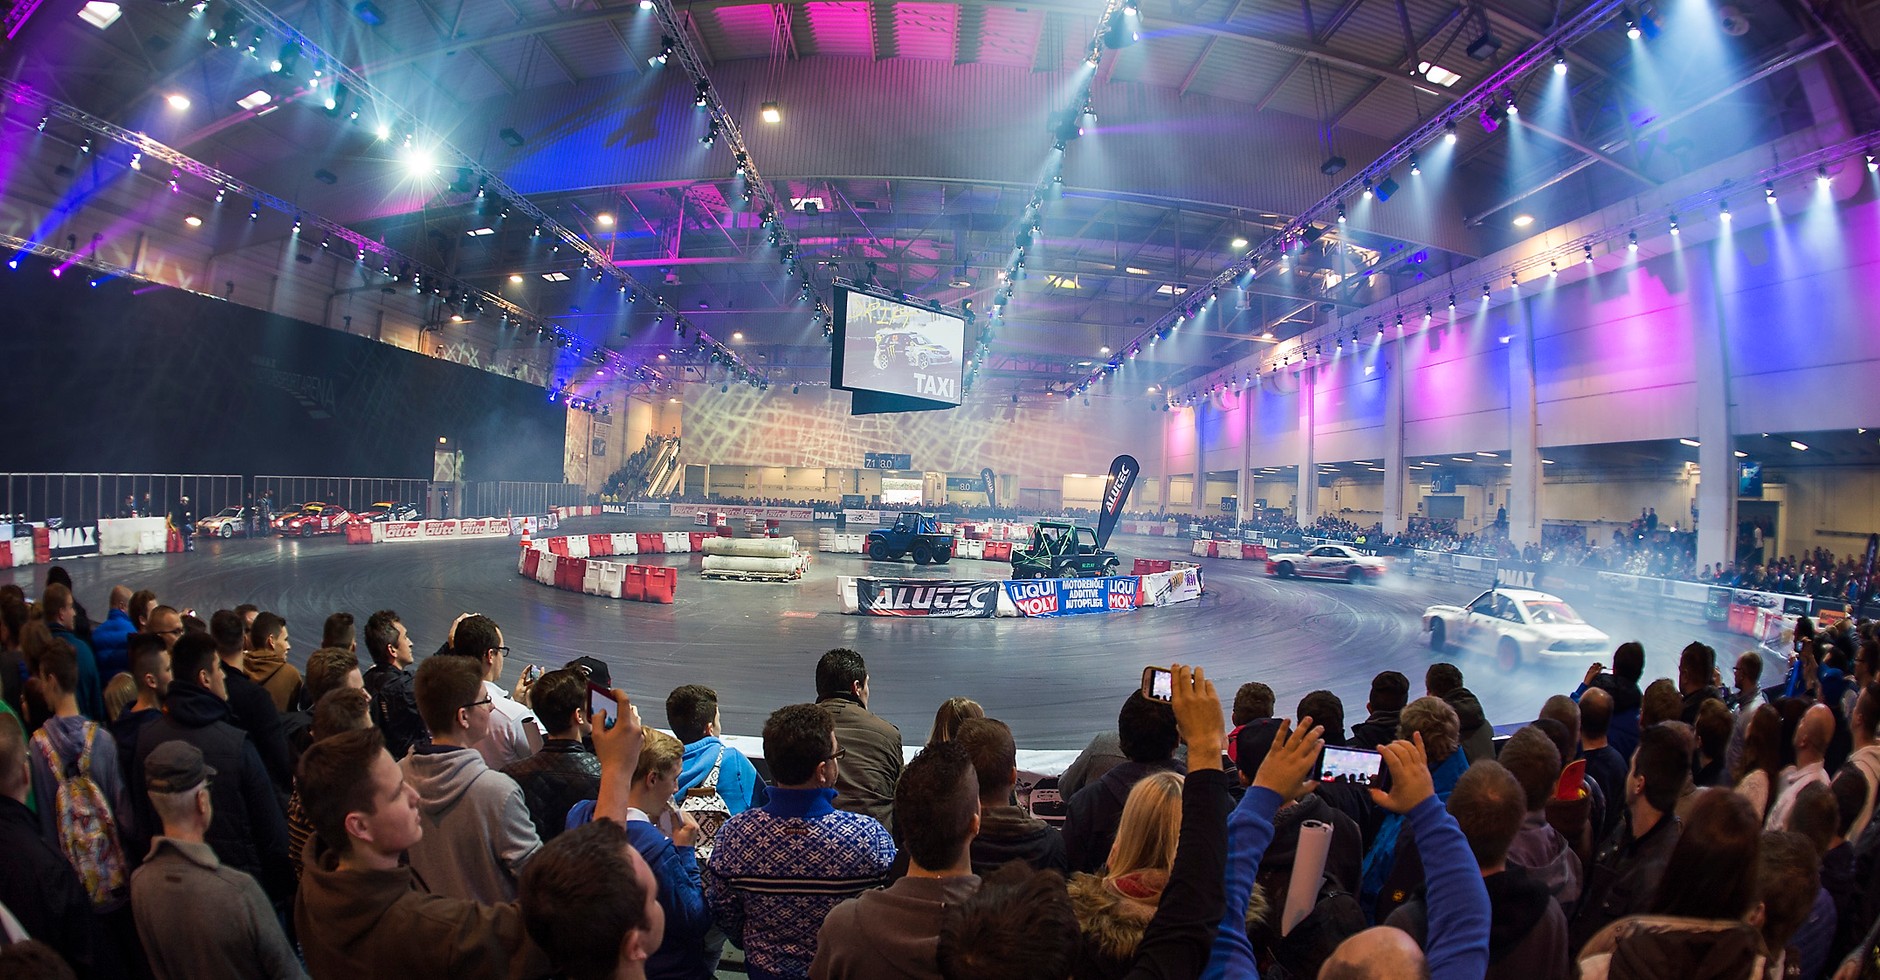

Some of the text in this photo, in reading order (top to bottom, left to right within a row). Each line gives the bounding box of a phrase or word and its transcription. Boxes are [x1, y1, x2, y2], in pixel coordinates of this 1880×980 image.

[913, 373, 955, 398] TAXI
[880, 459, 892, 468] 8.0
[959, 483, 971, 491] 8.0
[1106, 463, 1130, 514] ALUTEC
[603, 505, 626, 514] DMAX
[1221, 502, 1232, 510] 8.0
[387, 528, 418, 537] auto
[426, 526, 454, 536] auto
[462, 525, 484, 534] auto
[490, 525, 509, 533] auto
[1498, 568, 1535, 588] DMAX
[1013, 580, 1056, 600] LIQUI
[1110, 580, 1136, 594] LIQUI
[870, 587, 993, 610] ALUTEC
[1069, 589, 1098, 599] ADDITIVE
[1016, 596, 1057, 615] MOLY
[1065, 598, 1104, 610] AUTOPFLEGE
